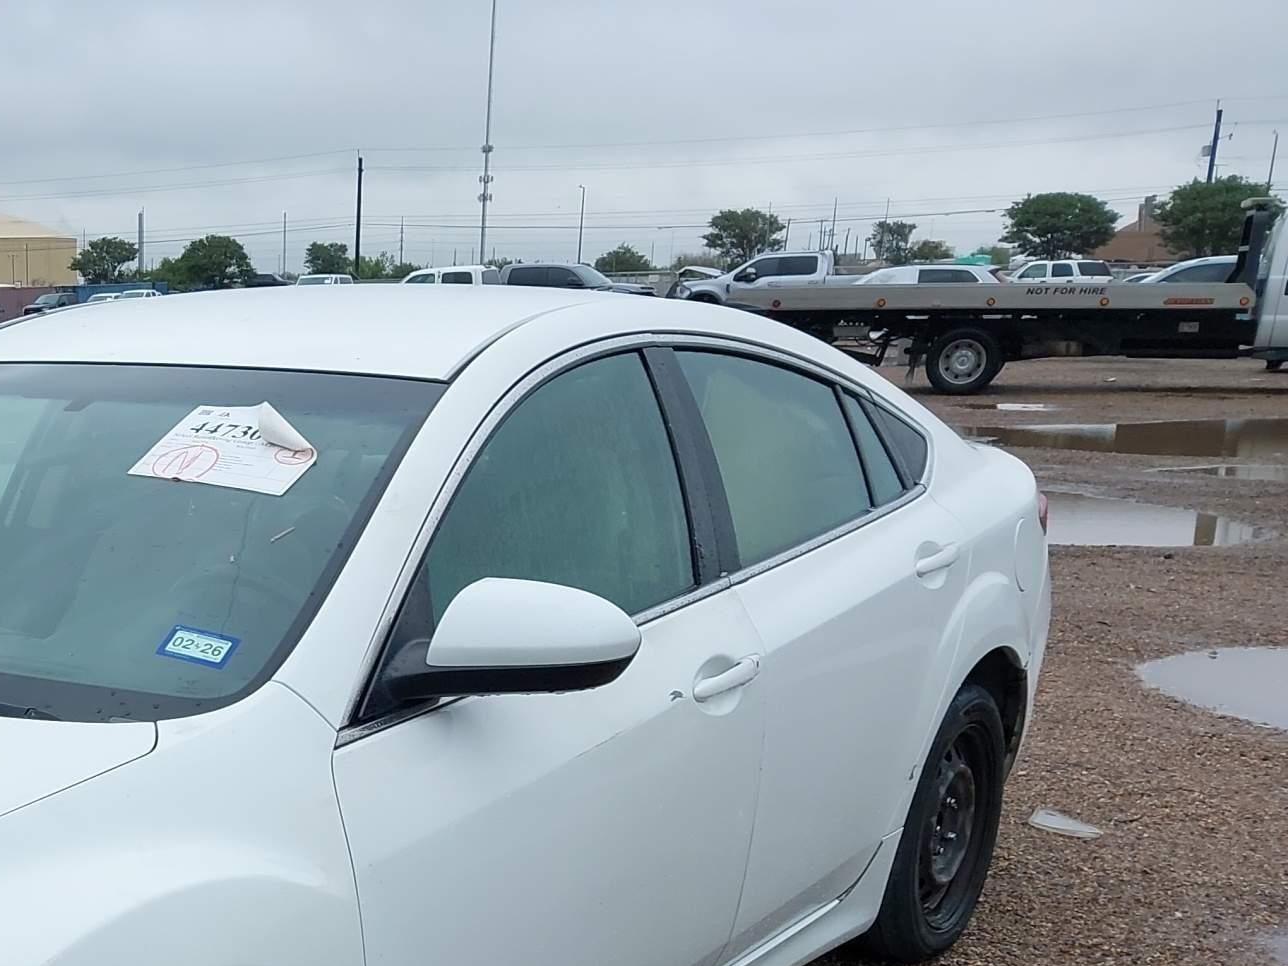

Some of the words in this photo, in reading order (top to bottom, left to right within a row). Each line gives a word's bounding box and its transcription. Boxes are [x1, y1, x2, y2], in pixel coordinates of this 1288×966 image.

[1026, 287, 1050, 295] NOT
[1053, 287, 1076, 295] FOR
[1079, 287, 1107, 295] HIRE
